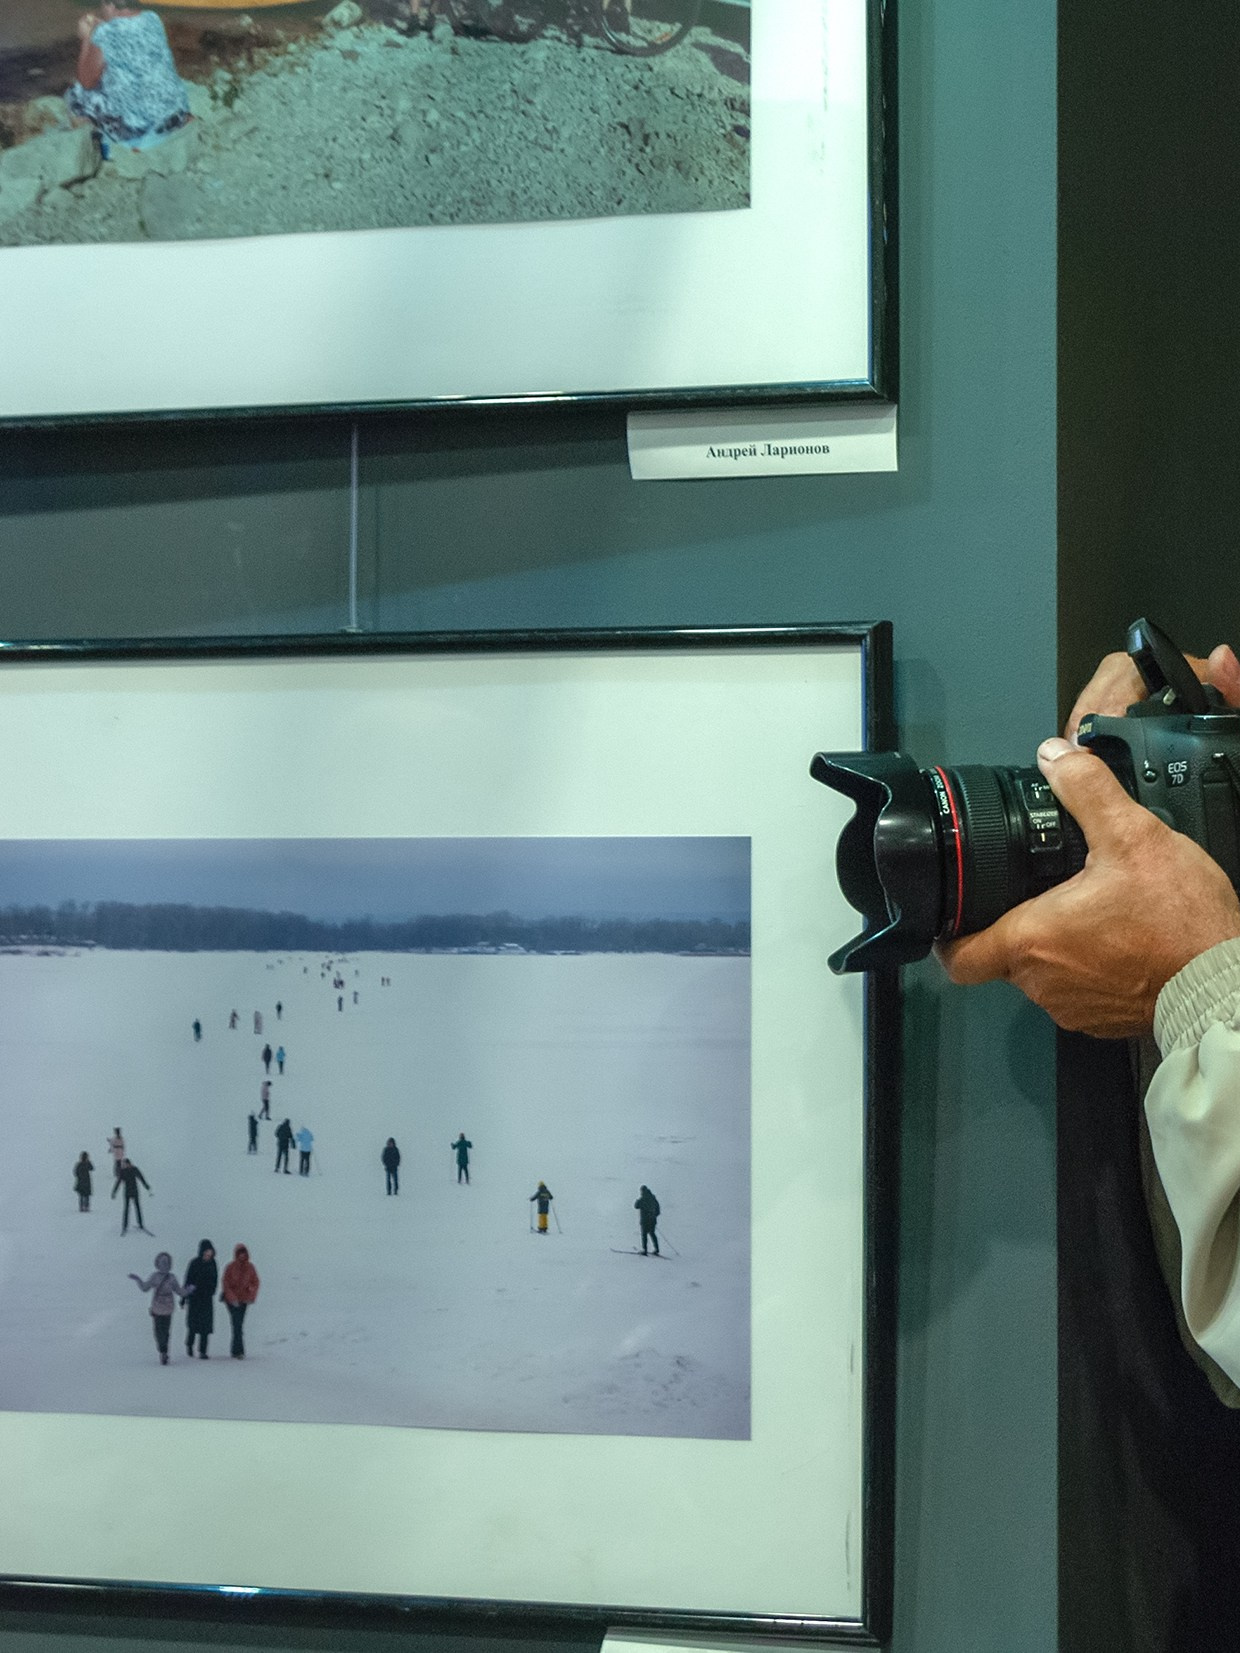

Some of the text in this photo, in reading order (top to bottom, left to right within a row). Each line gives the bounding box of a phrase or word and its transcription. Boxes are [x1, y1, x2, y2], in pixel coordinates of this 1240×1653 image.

[706, 443, 830, 460] Андрей Ларионов
[1167, 760, 1188, 774] EOS
[932, 774, 945, 790] ZOOM
[1171, 773, 1184, 785] 7D
[939, 790, 951, 815] CANON
